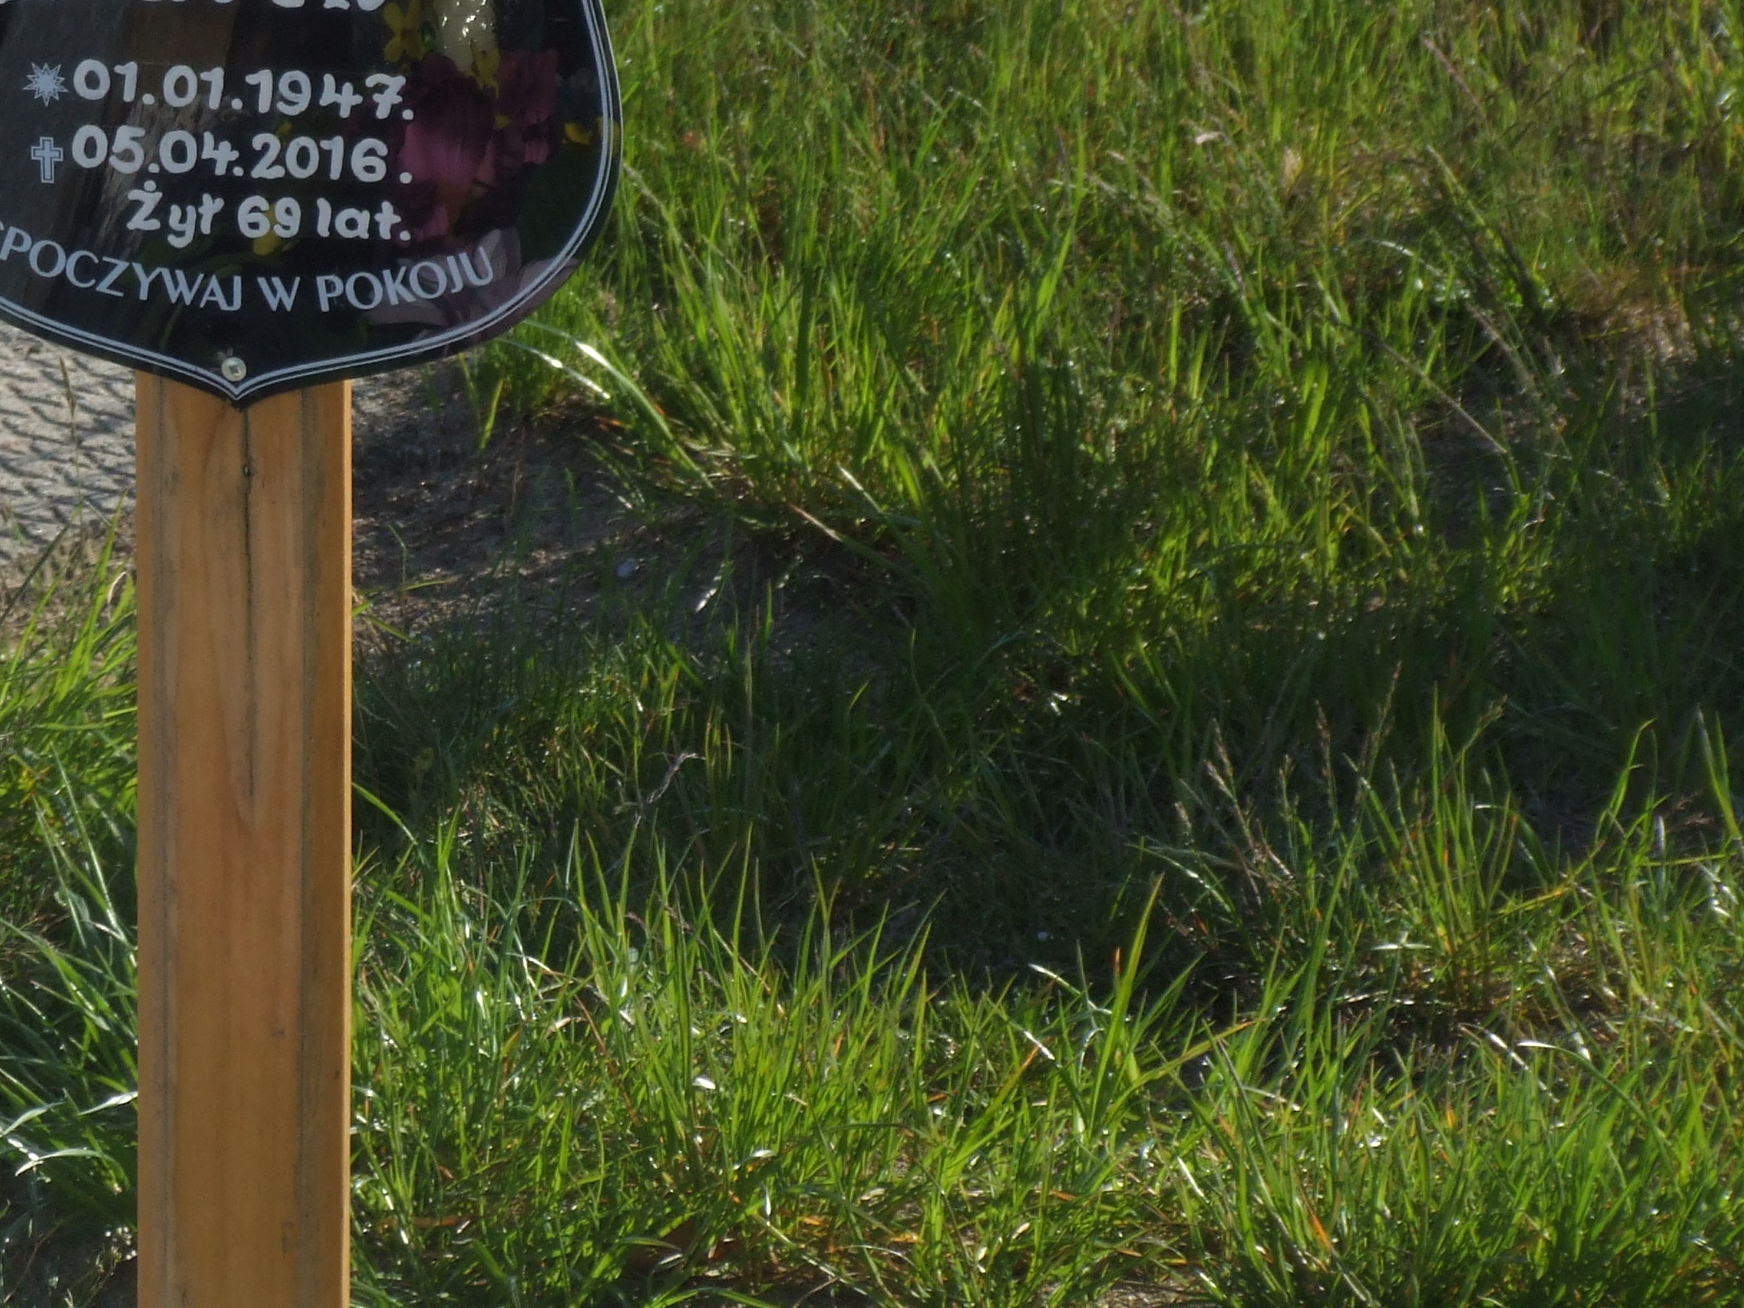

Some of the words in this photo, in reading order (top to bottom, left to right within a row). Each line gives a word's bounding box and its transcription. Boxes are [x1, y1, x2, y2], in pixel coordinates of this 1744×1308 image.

[73, 59, 415, 121] 01.01.1947.
[127, 180, 224, 247] Żył
[239, 196, 301, 237] 69
[317, 197, 411, 242] lat.
[259, 275, 301, 313] W
[319, 248, 495, 310] POKOJU
